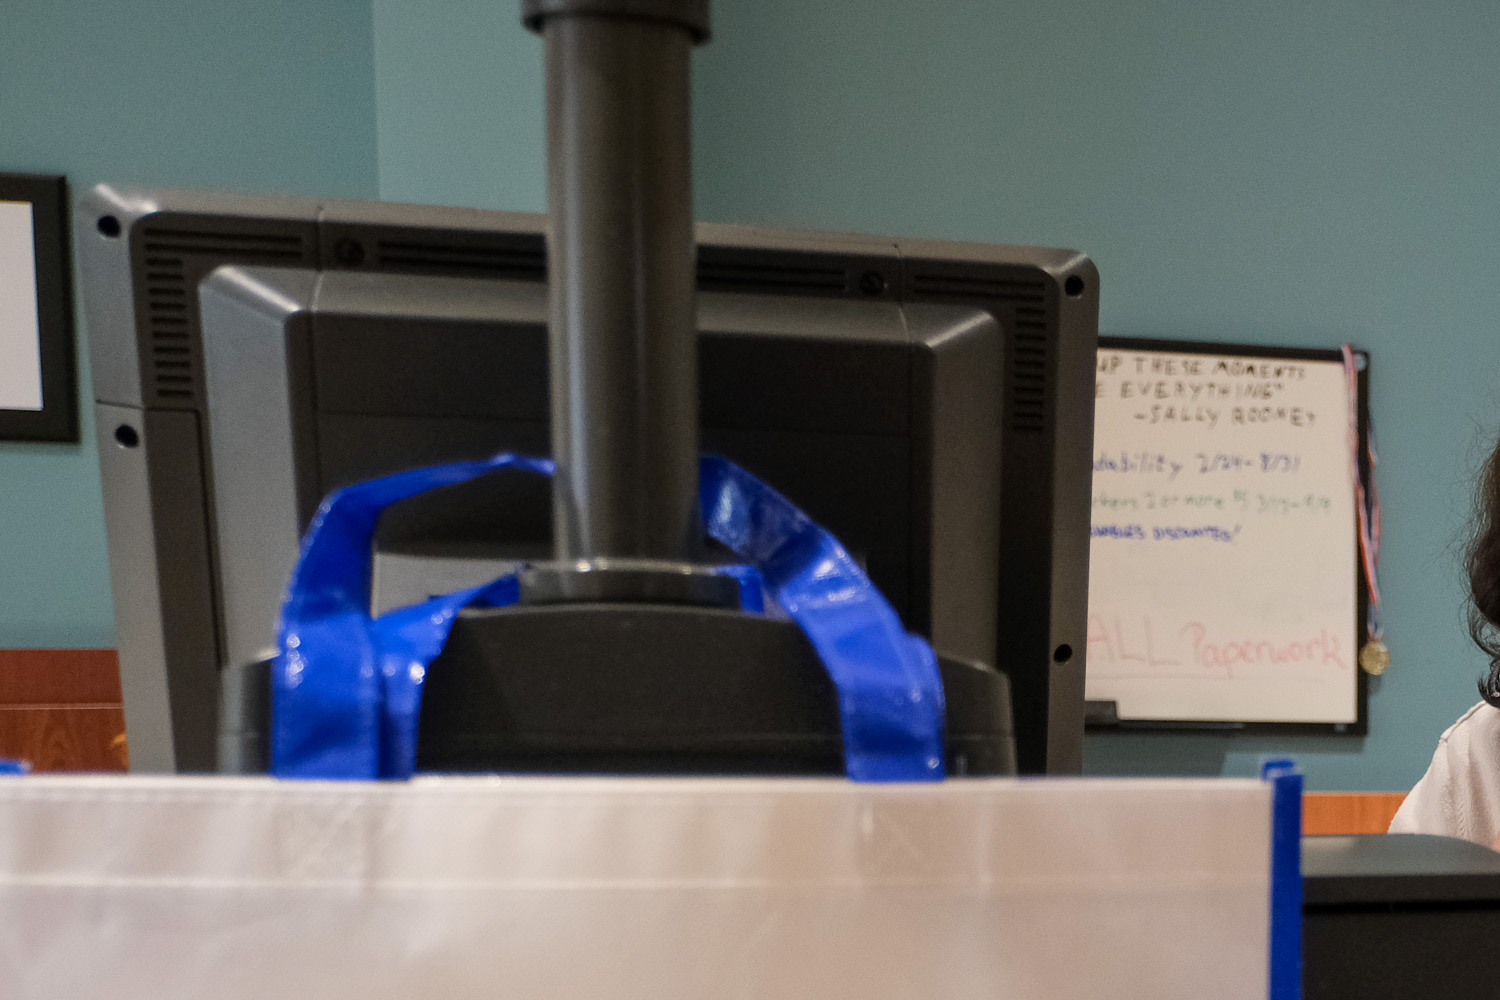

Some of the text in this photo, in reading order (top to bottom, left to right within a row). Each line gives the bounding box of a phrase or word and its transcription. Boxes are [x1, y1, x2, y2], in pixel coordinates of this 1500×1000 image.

[1133, 356, 1202, 376] THESE
[1212, 360, 1306, 380] MOMENTS
[1231, 405, 1318, 428] ROONEY
[1178, 620, 1349, 679] Paperwork
